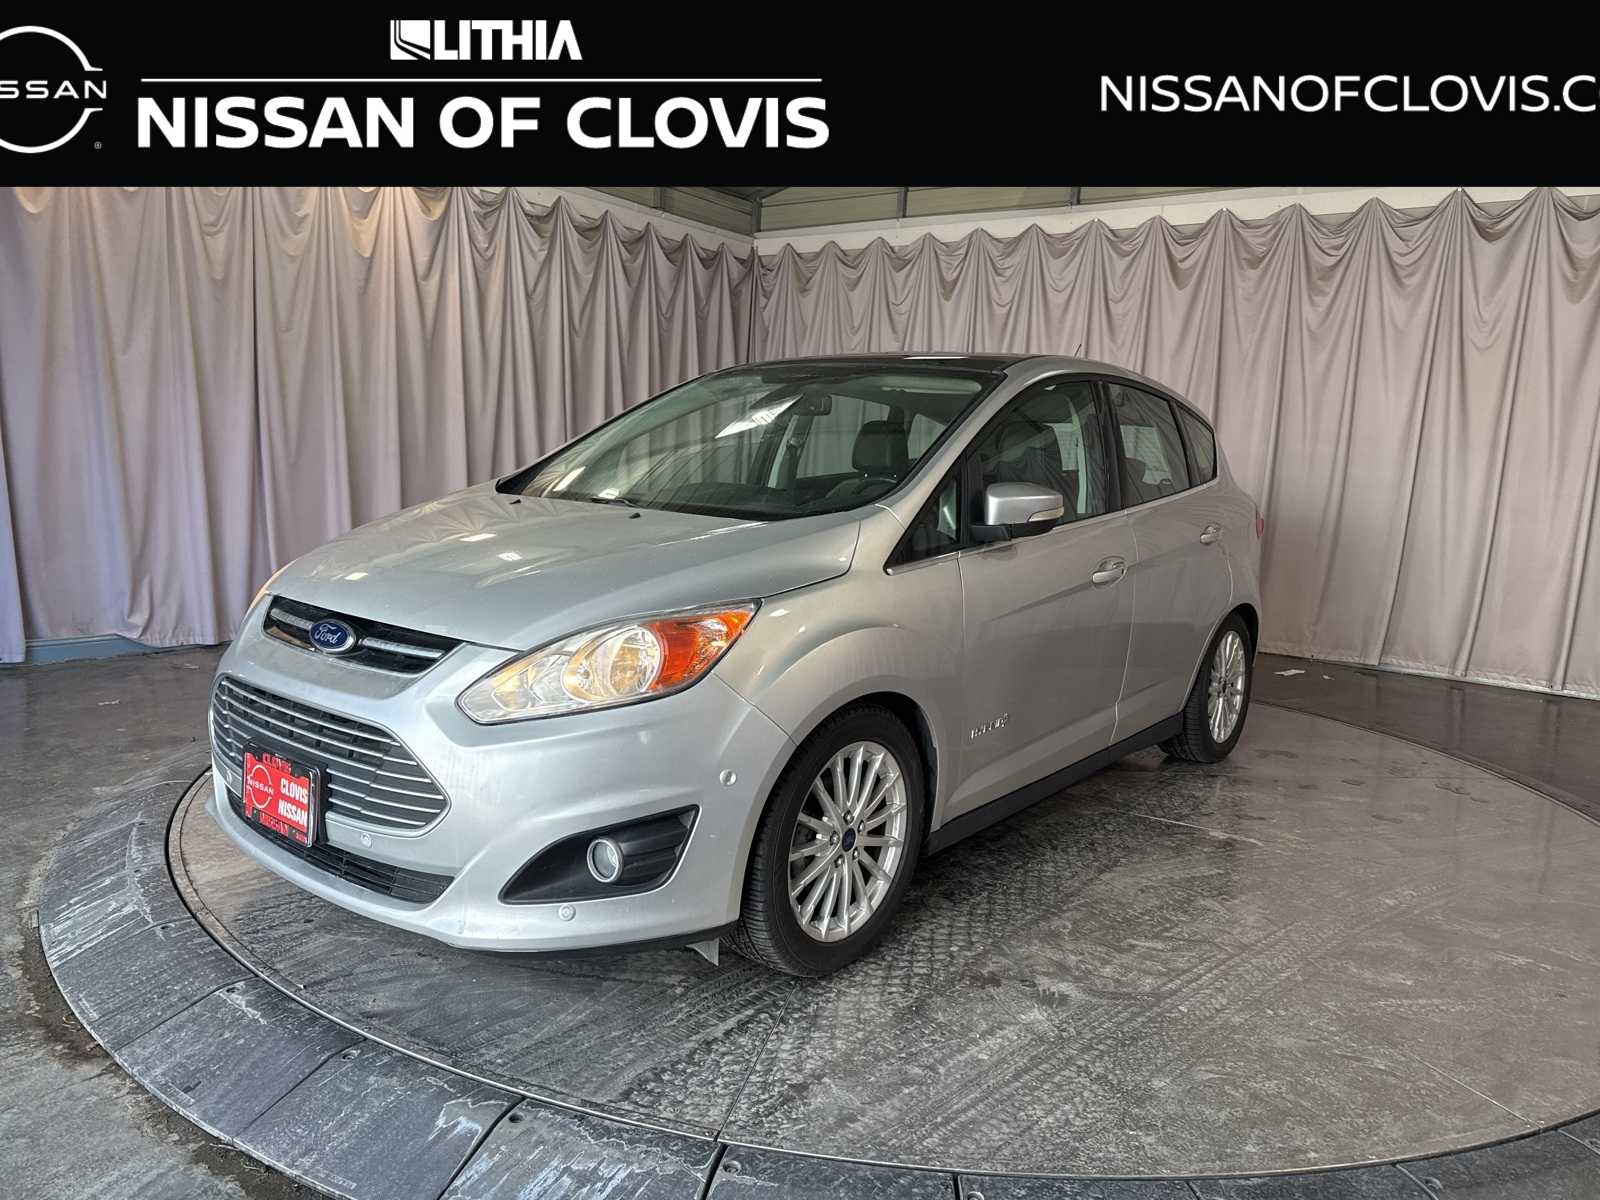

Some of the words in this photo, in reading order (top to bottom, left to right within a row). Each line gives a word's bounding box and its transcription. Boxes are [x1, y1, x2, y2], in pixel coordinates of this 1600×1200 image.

[314, 623, 342, 644] Ford
[247, 778, 274, 795] NISSAN
[280, 778, 308, 804] CLOVIS
[278, 799, 308, 827] NISSAN
